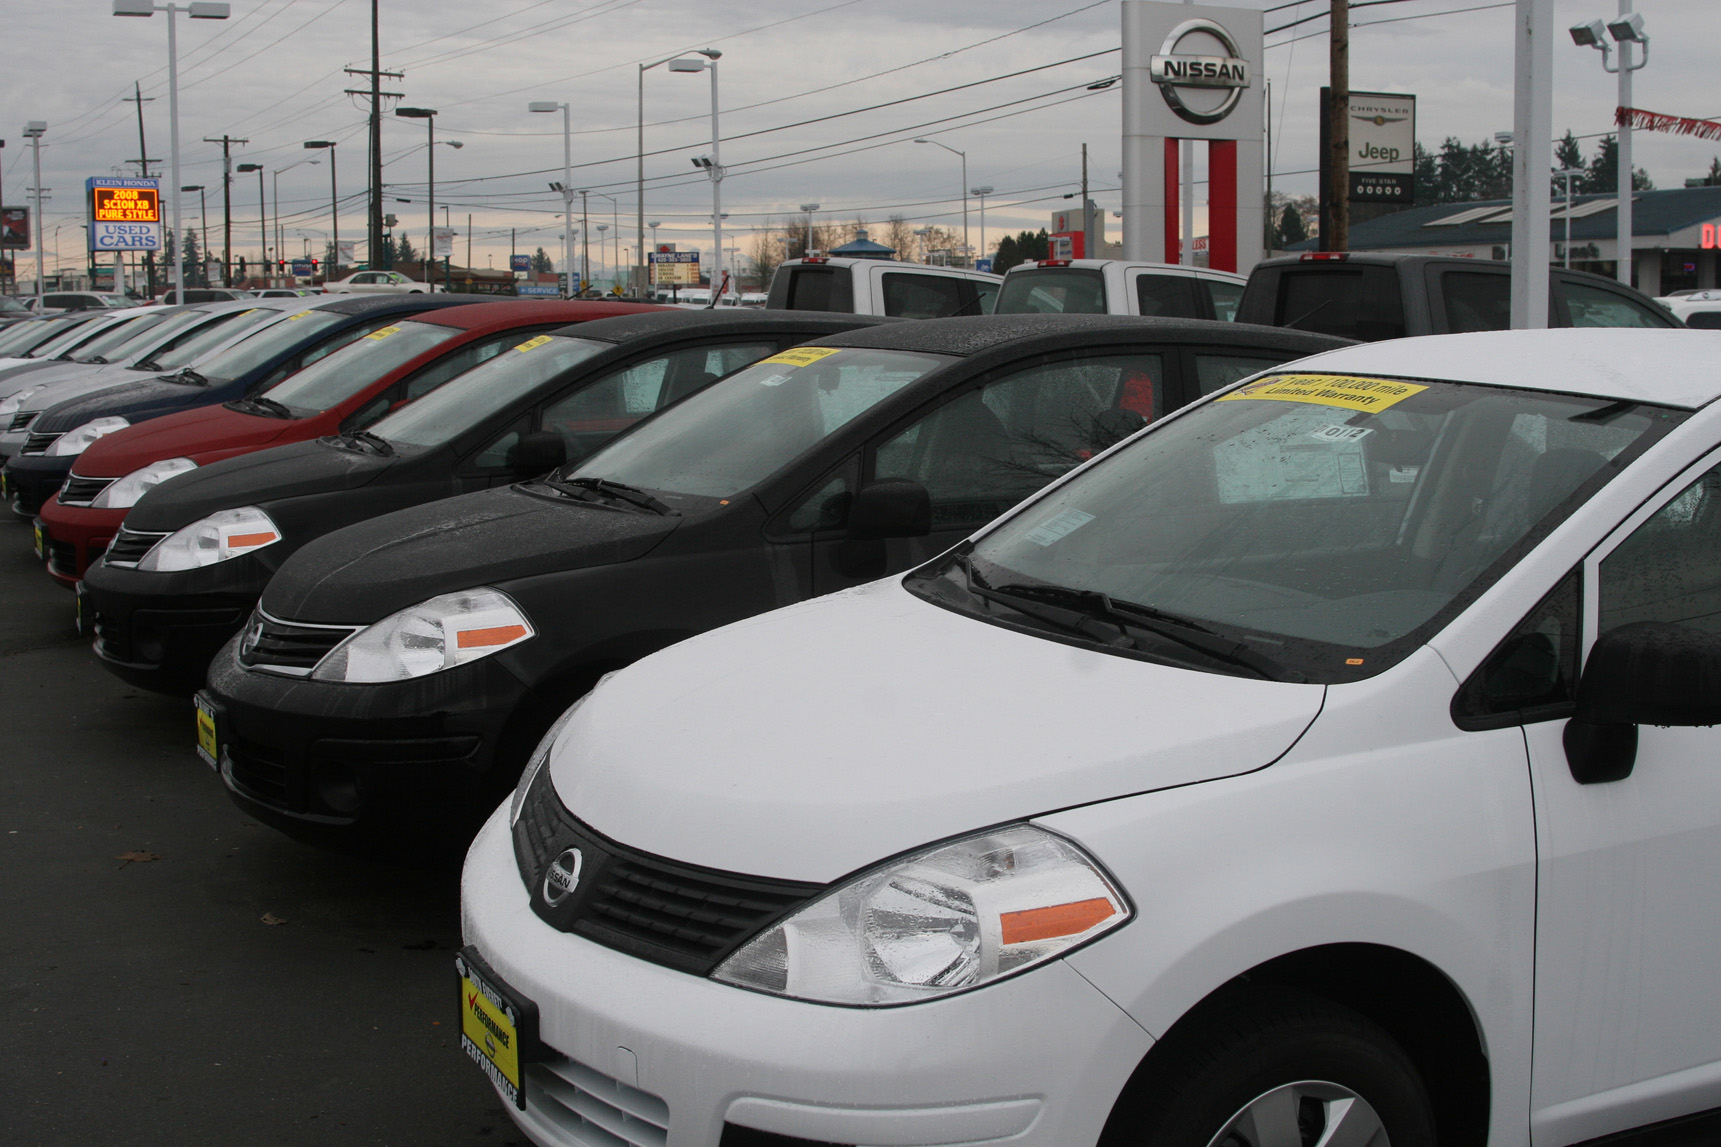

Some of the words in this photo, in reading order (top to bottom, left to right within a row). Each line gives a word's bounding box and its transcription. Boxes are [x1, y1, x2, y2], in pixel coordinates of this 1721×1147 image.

[1164, 60, 1244, 81] NISSAN
[1350, 105, 1409, 114] CHRYSLER
[1358, 141, 1400, 163] Jeep
[113, 190, 139, 200] 2008
[103, 199, 135, 209] SCION
[136, 200, 150, 210] XB
[99, 209, 124, 218] PURE
[125, 209, 154, 219] STYLE
[104, 225, 151, 235] USED
[99, 235, 157, 247] CARS
[1325, 378, 1381, 391] 100,000
[1372, 384, 1409, 396] mile
[1265, 387, 1319, 396] Limited
[1314, 388, 1381, 406] Warranty
[474, 1002, 510, 1049] PERFORMANCE
[461, 1033, 518, 1106] PERFORMANCE
